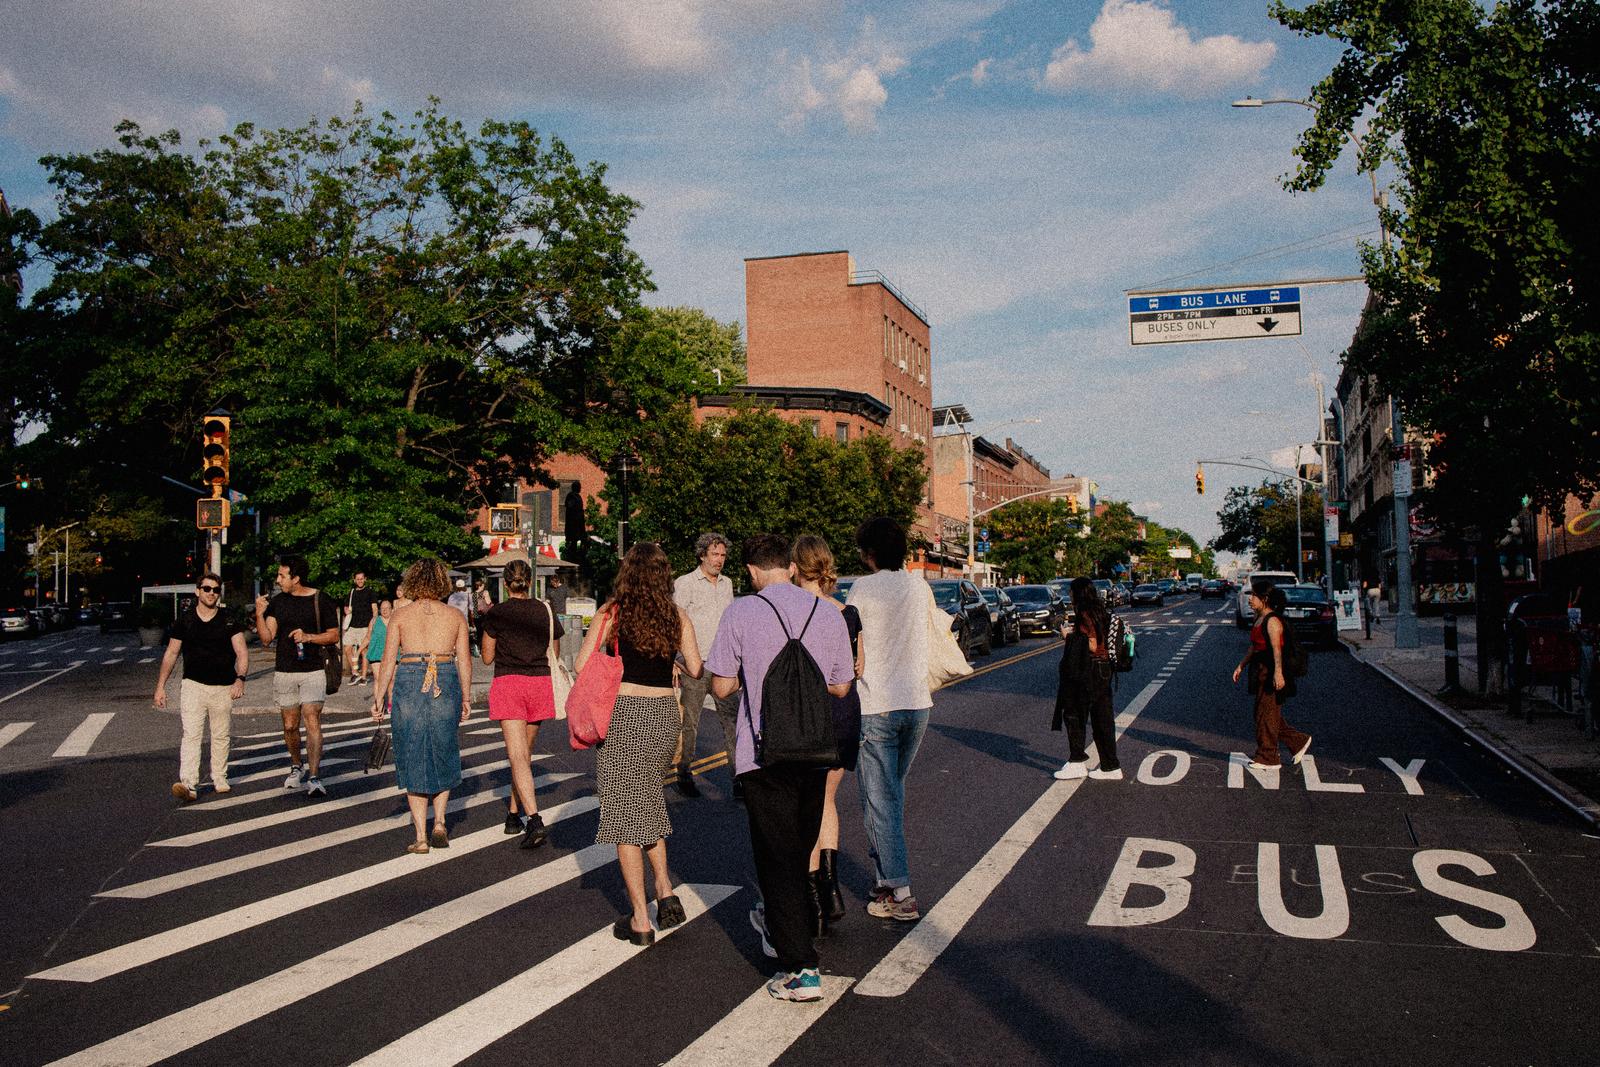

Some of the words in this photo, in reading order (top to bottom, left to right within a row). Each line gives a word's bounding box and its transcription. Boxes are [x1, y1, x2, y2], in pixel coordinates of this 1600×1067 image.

[1181, 296, 1204, 307] BUS
[1215, 293, 1248, 305] LANE
[1184, 311, 1201, 319] 7PM
[1236, 307, 1254, 315] MON
[1148, 322, 1183, 333] BUSES
[1187, 320, 1217, 331] ONLY
[1136, 749, 1426, 796] ONLY
[1086, 837, 1537, 952] BUS
